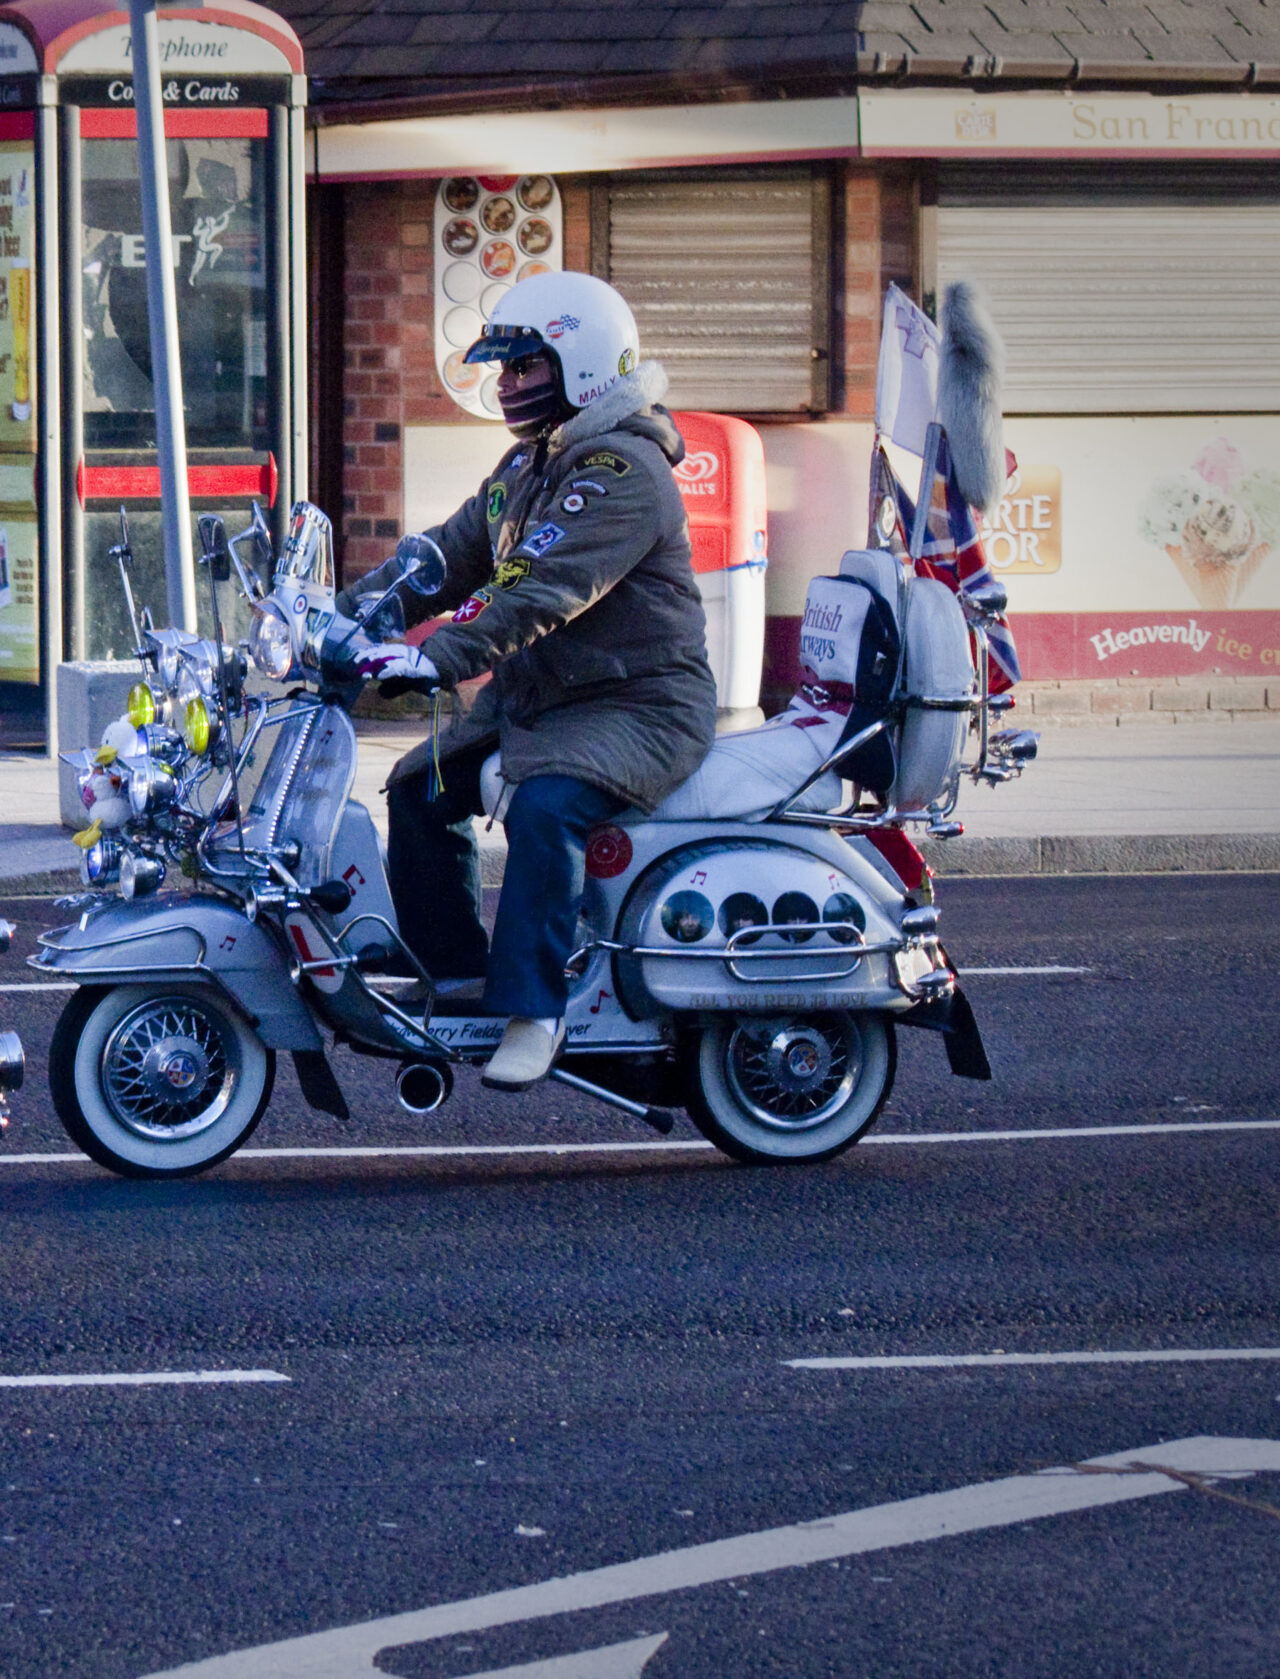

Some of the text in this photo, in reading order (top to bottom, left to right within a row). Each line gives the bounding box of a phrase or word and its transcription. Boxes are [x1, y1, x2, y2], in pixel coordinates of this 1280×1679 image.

[121, 36, 229, 61] Tephone
[163, 80, 240, 101] & Cards
[1072, 104, 1149, 140] San
[583, 454, 616, 468] VESPA
[981, 494, 1053, 536] RTE
[800, 634, 836, 662] rways
[1089, 618, 1212, 662] Heavenly
[1215, 628, 1254, 661] ice
[459, 1022, 504, 1039] Fields
